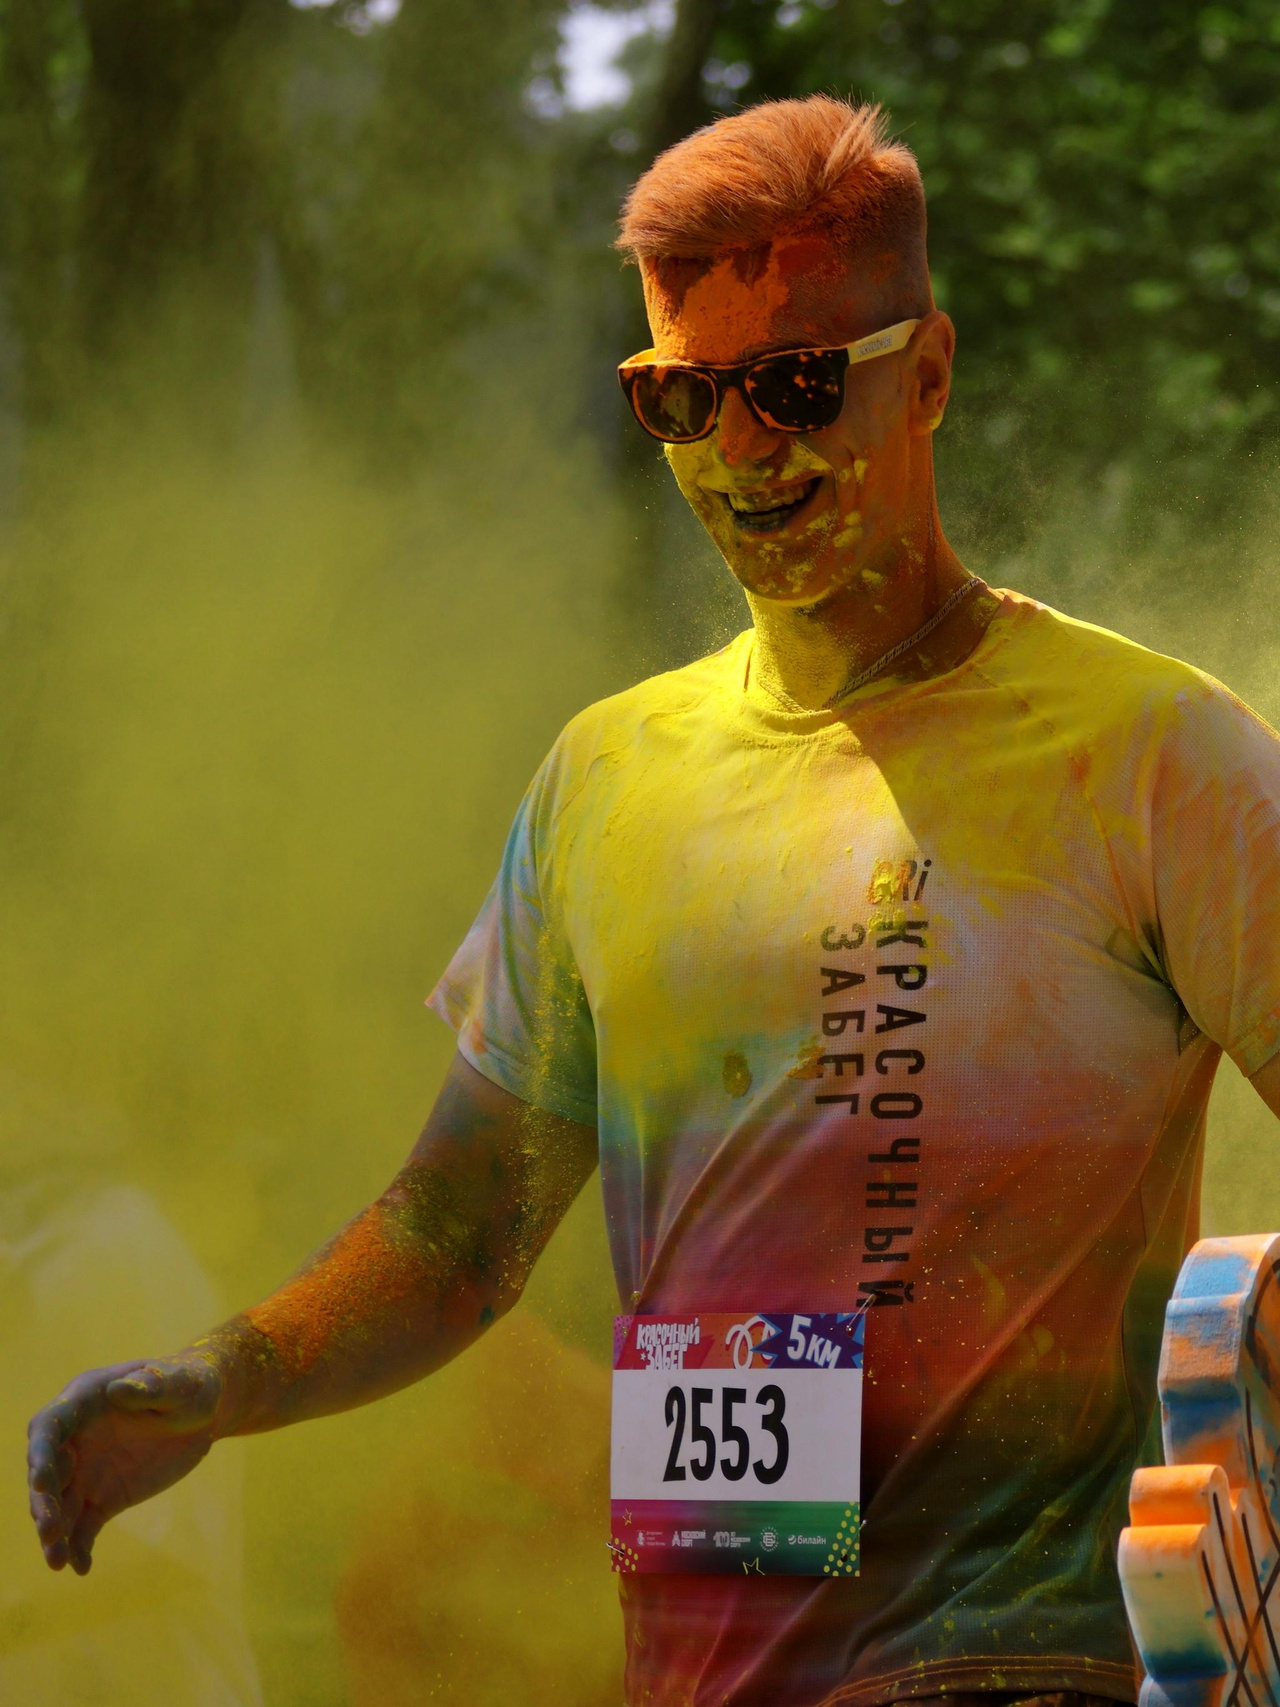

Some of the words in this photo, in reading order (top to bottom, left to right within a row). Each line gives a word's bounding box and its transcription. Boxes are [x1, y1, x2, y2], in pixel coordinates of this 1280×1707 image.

[814, 921, 866, 1116] ЗАБЕГ
[856, 919, 929, 1308] КРАСОЧНЫЙ
[636, 1318, 700, 1350] КРАСОЧНЫЙ
[645, 1342, 687, 1369] ЗАБЕГ
[663, 1384, 790, 1485] 2553
[797, 1534, 826, 1546] билайн
